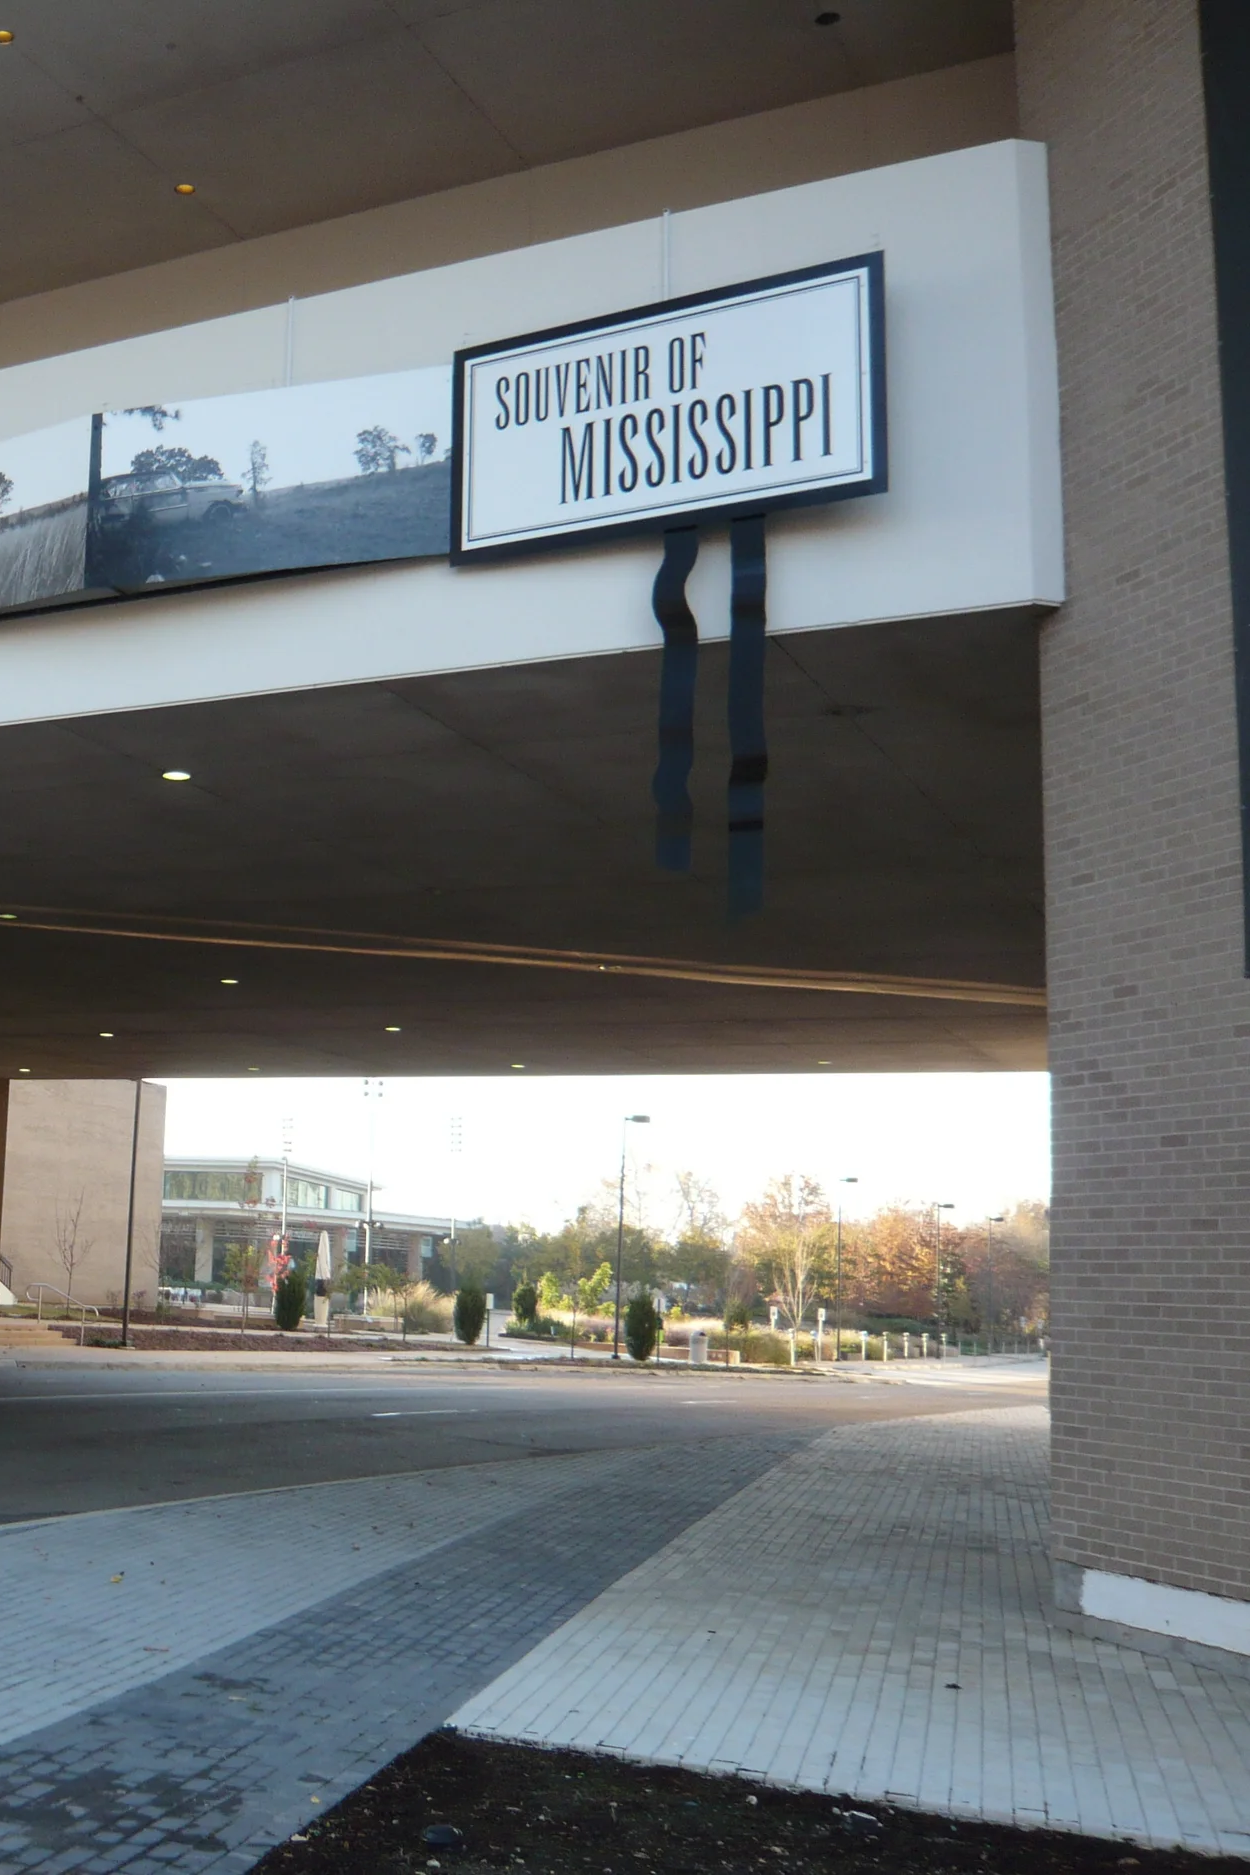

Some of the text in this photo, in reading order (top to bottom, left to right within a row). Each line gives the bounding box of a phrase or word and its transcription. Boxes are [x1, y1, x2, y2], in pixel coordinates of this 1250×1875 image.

[494, 331, 707, 430] SOUVENIR OF
[558, 372, 833, 505] MISSISSIPPI
